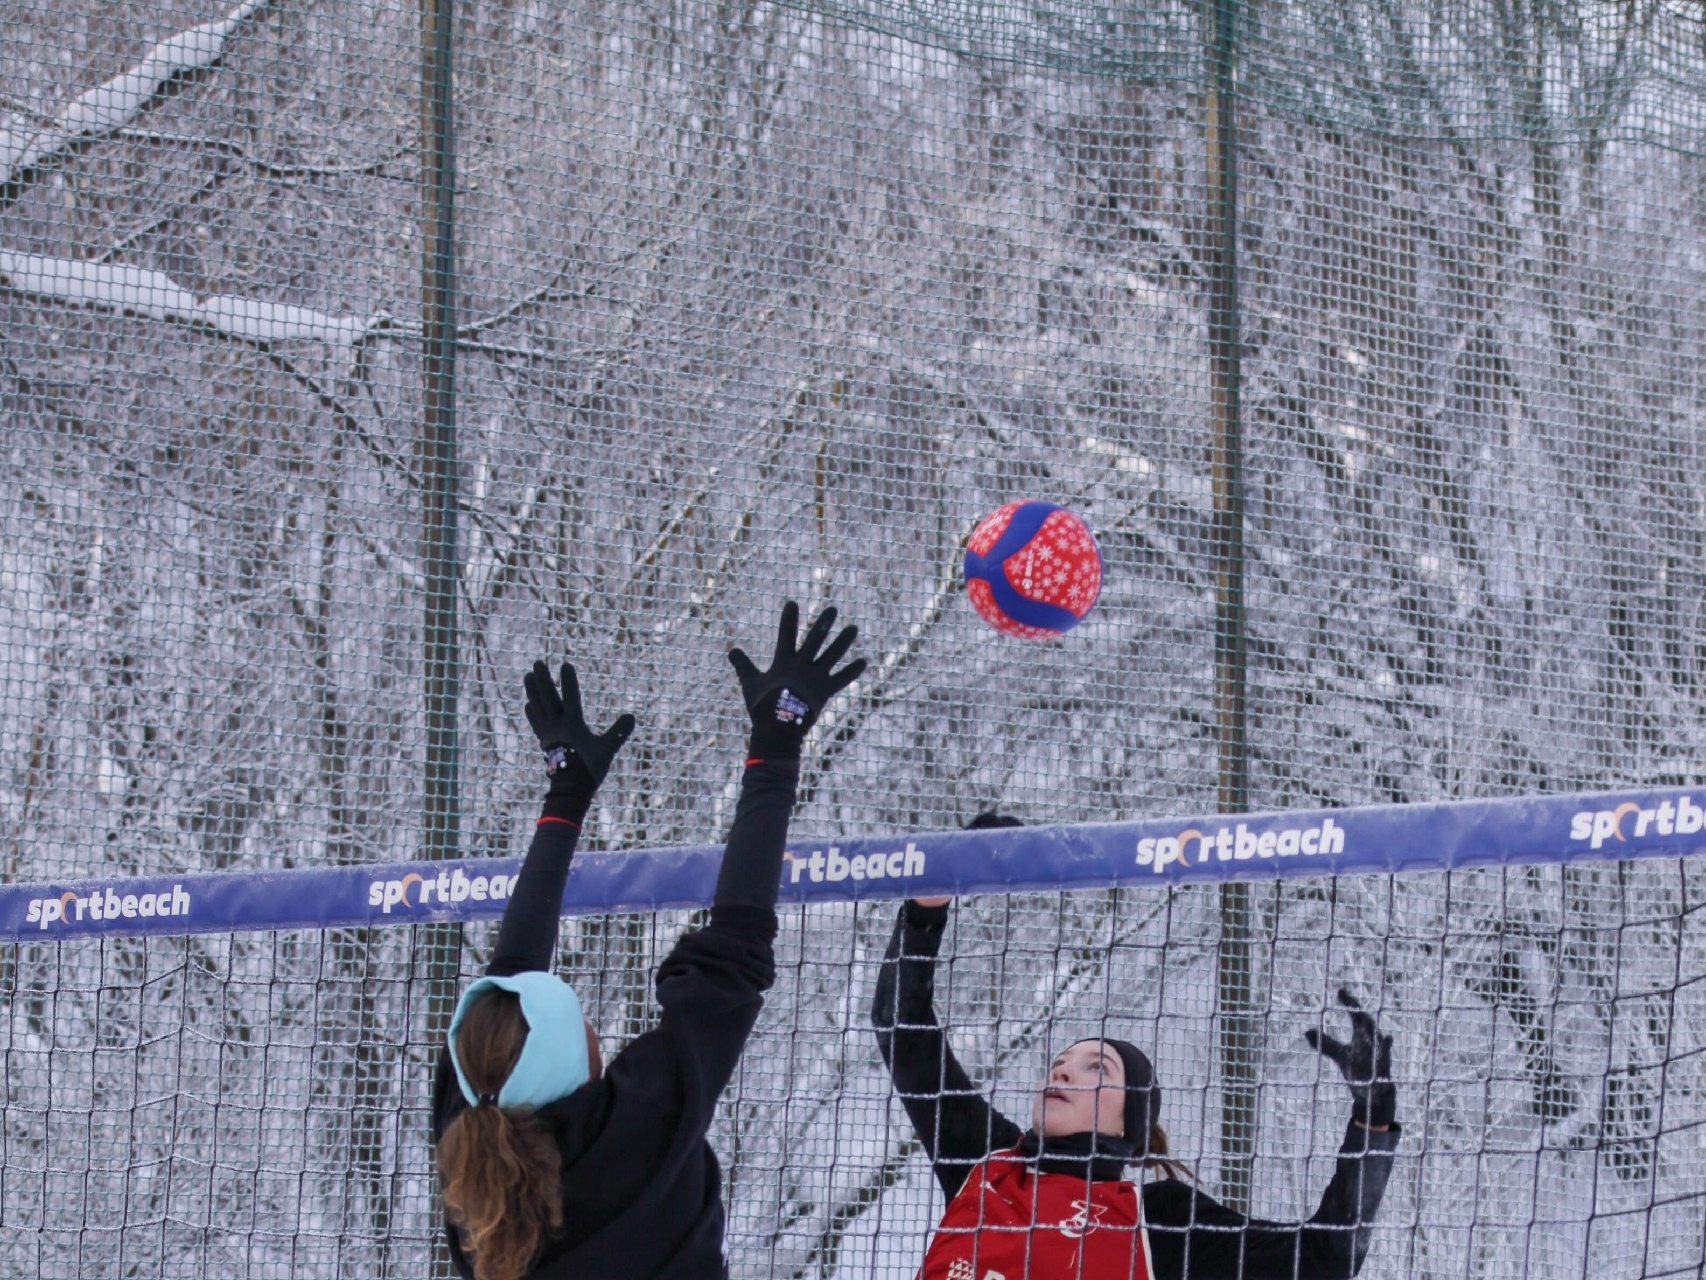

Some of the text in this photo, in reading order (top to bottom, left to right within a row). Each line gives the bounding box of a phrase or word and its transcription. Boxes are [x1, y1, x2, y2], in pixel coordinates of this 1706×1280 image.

[1135, 818, 1345, 873] sportbeach
[1569, 796, 1706, 849] sportb
[26, 884, 191, 930] sportbeach
